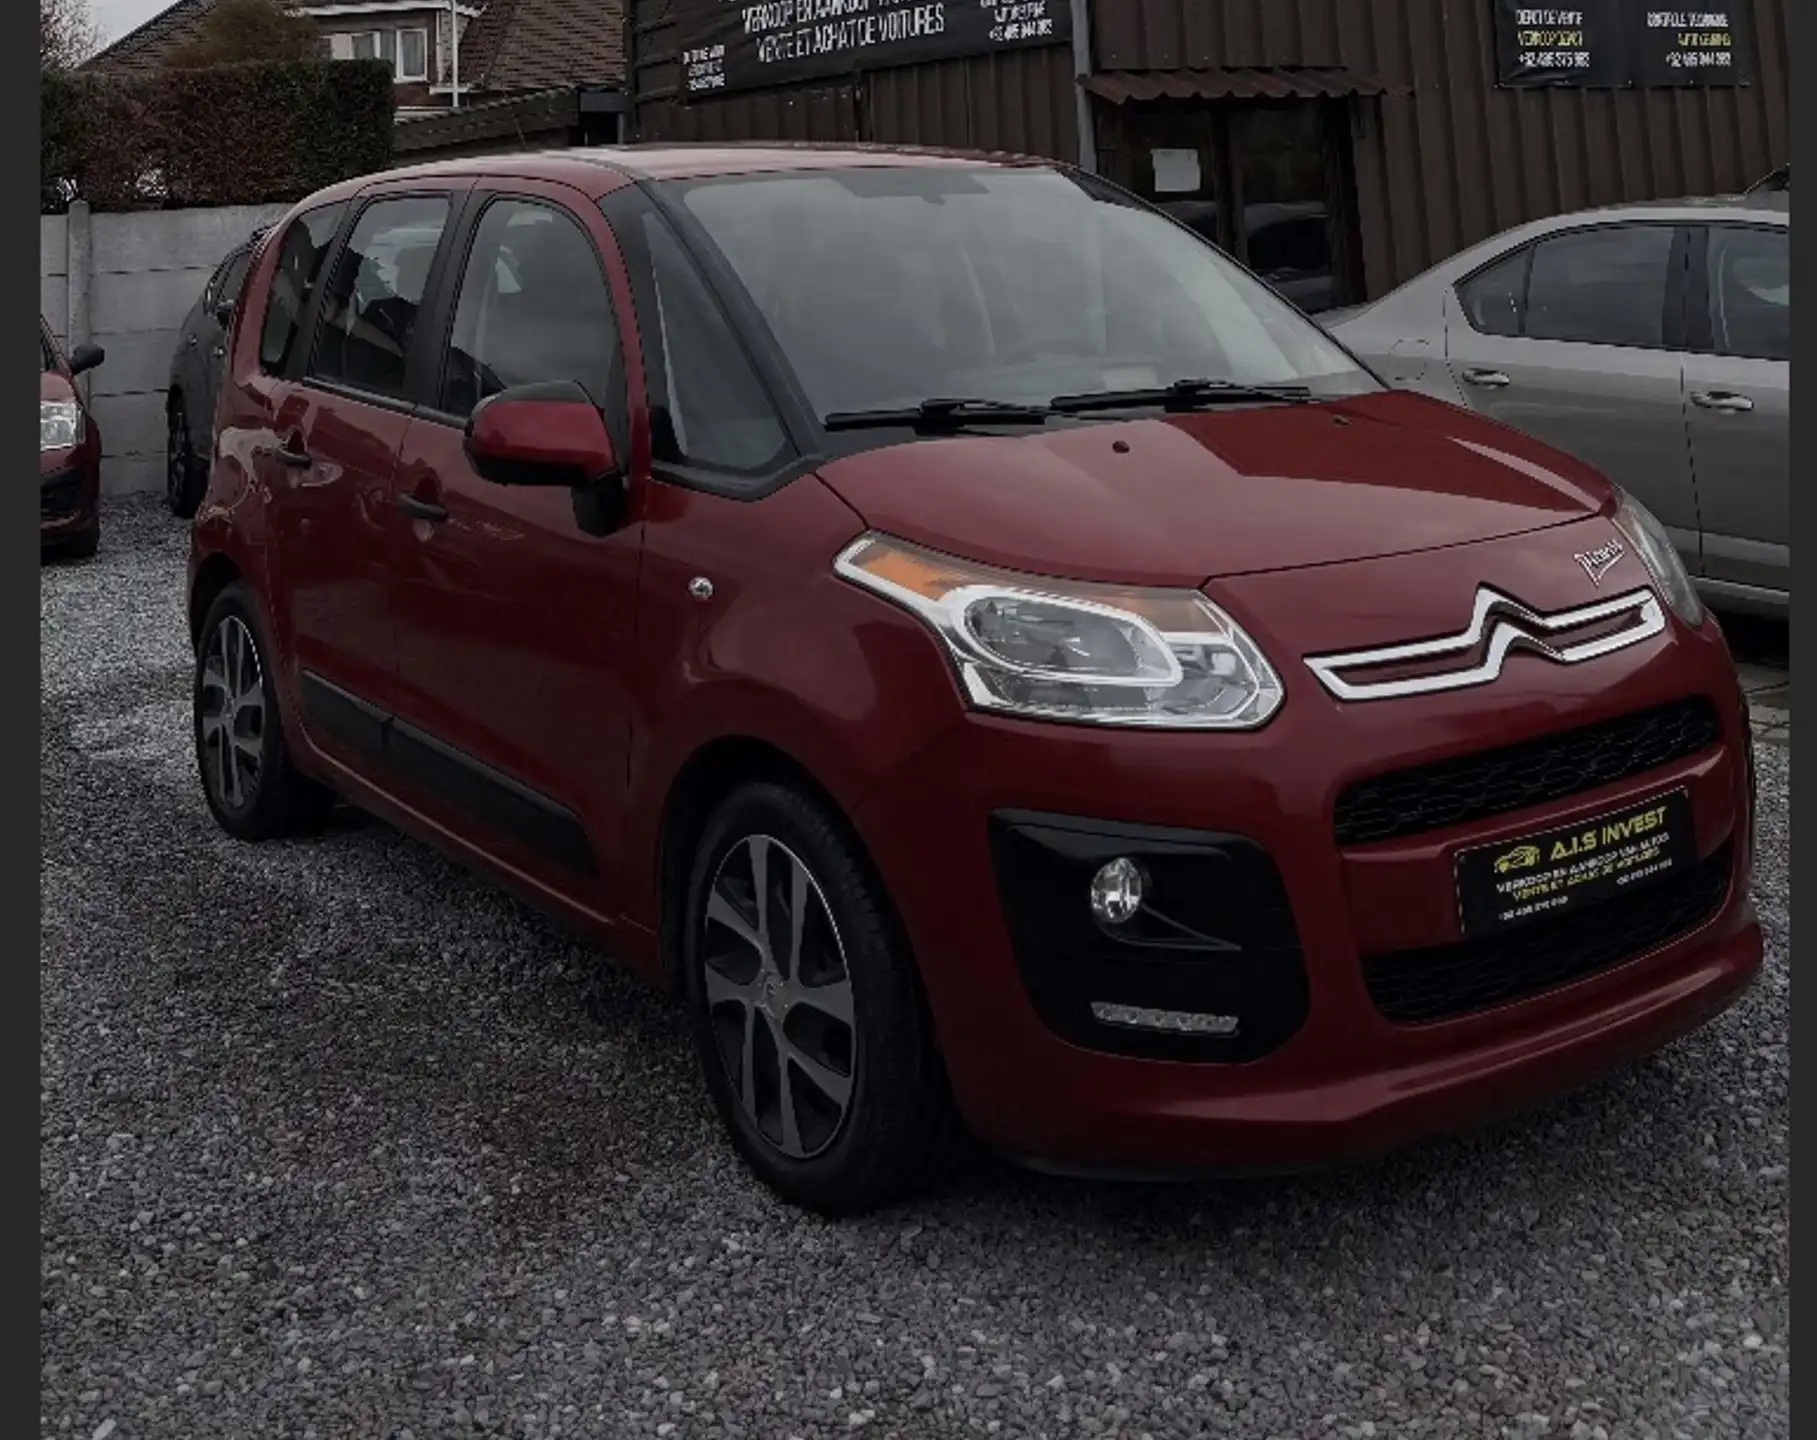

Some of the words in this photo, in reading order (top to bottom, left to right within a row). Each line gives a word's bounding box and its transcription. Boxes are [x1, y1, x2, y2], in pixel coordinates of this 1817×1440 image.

[796, 28, 811, 58] ET
[813, 18, 856, 53] ACHAT
[858, 16, 876, 46] DE
[878, 3, 945, 42] VOITURES
[1549, 829, 1597, 861] A.I.S
[1601, 806, 1667, 845] INVEST
